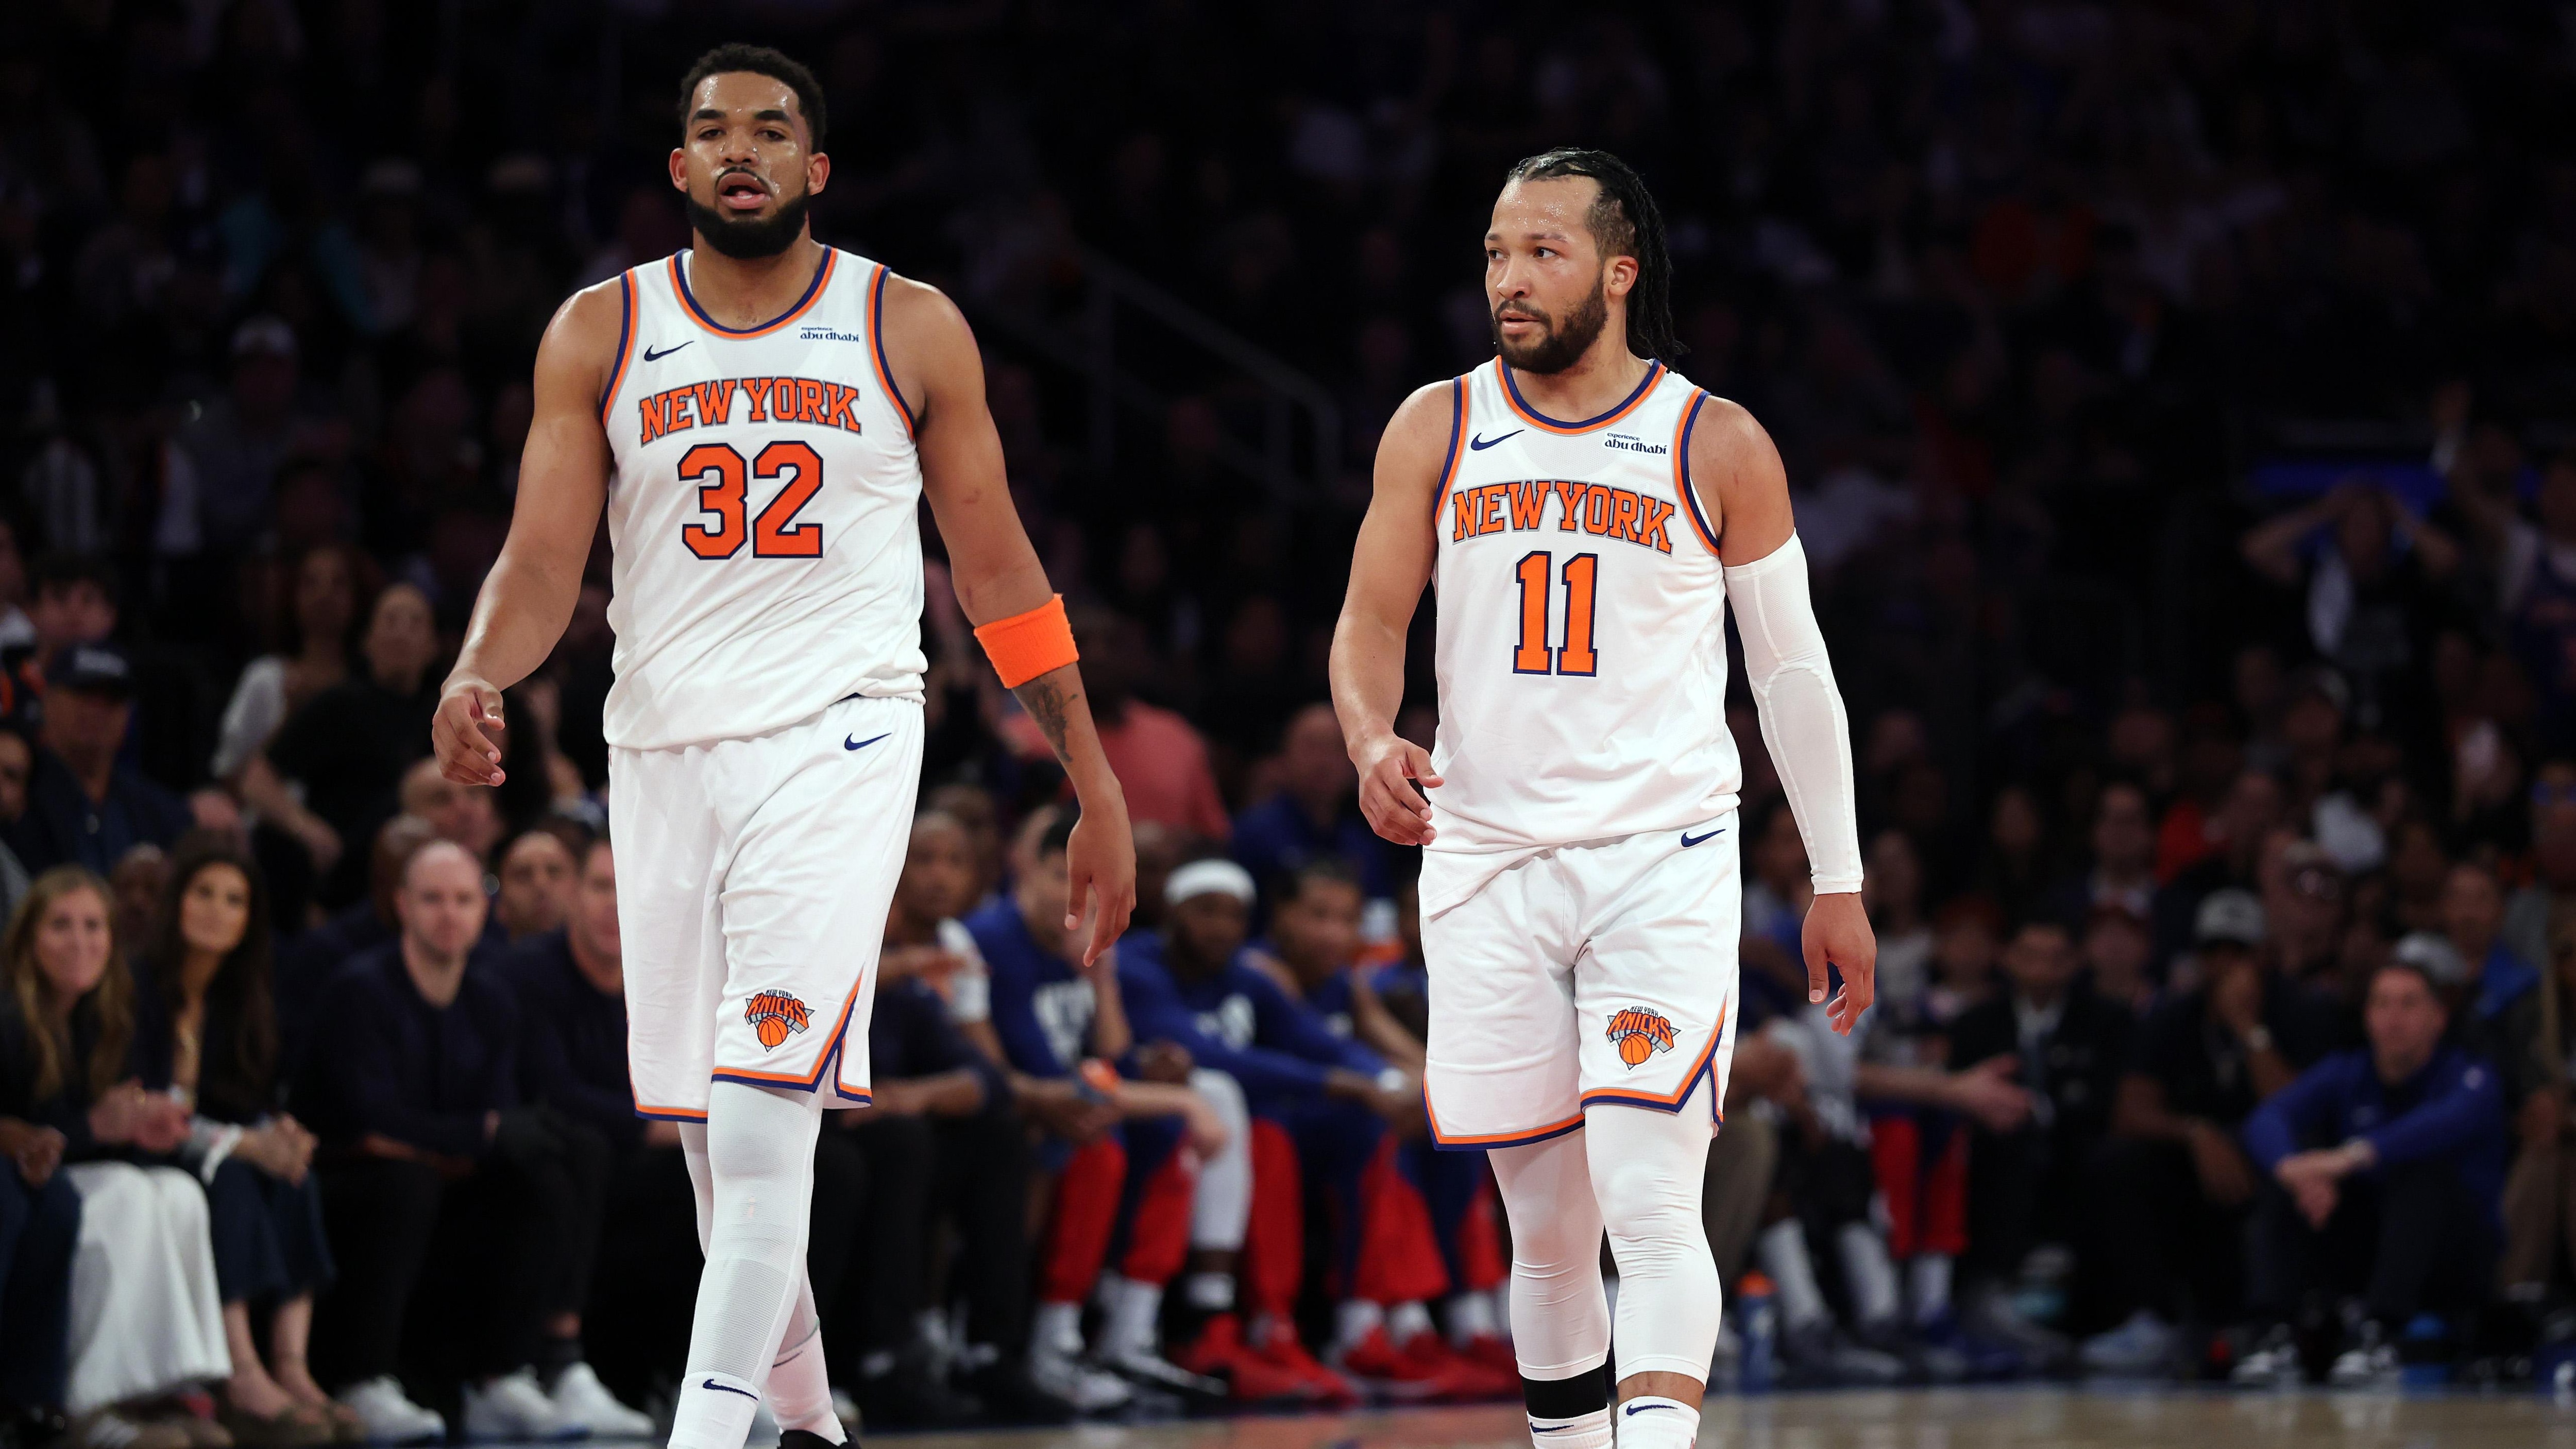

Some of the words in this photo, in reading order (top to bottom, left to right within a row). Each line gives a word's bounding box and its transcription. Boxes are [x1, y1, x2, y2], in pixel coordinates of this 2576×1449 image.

[825, 332, 859, 342] dhabi
[638, 378, 738, 447] NEW
[741, 376, 862, 436] YORK
[1604, 438, 1629, 450] abu
[1631, 442, 1667, 454] dhabi
[1607, 432, 1640, 441] experience
[677, 440, 823, 559] 32
[1452, 479, 1551, 545] NEW
[1553, 479, 1675, 557] YORK
[1513, 551, 1598, 677] 11
[745, 993, 809, 1029] KNICKS
[778, 990, 793, 998] YORK
[1644, 1007, 1658, 1017] YORK
[1606, 1009, 1674, 1048] KNICKS
